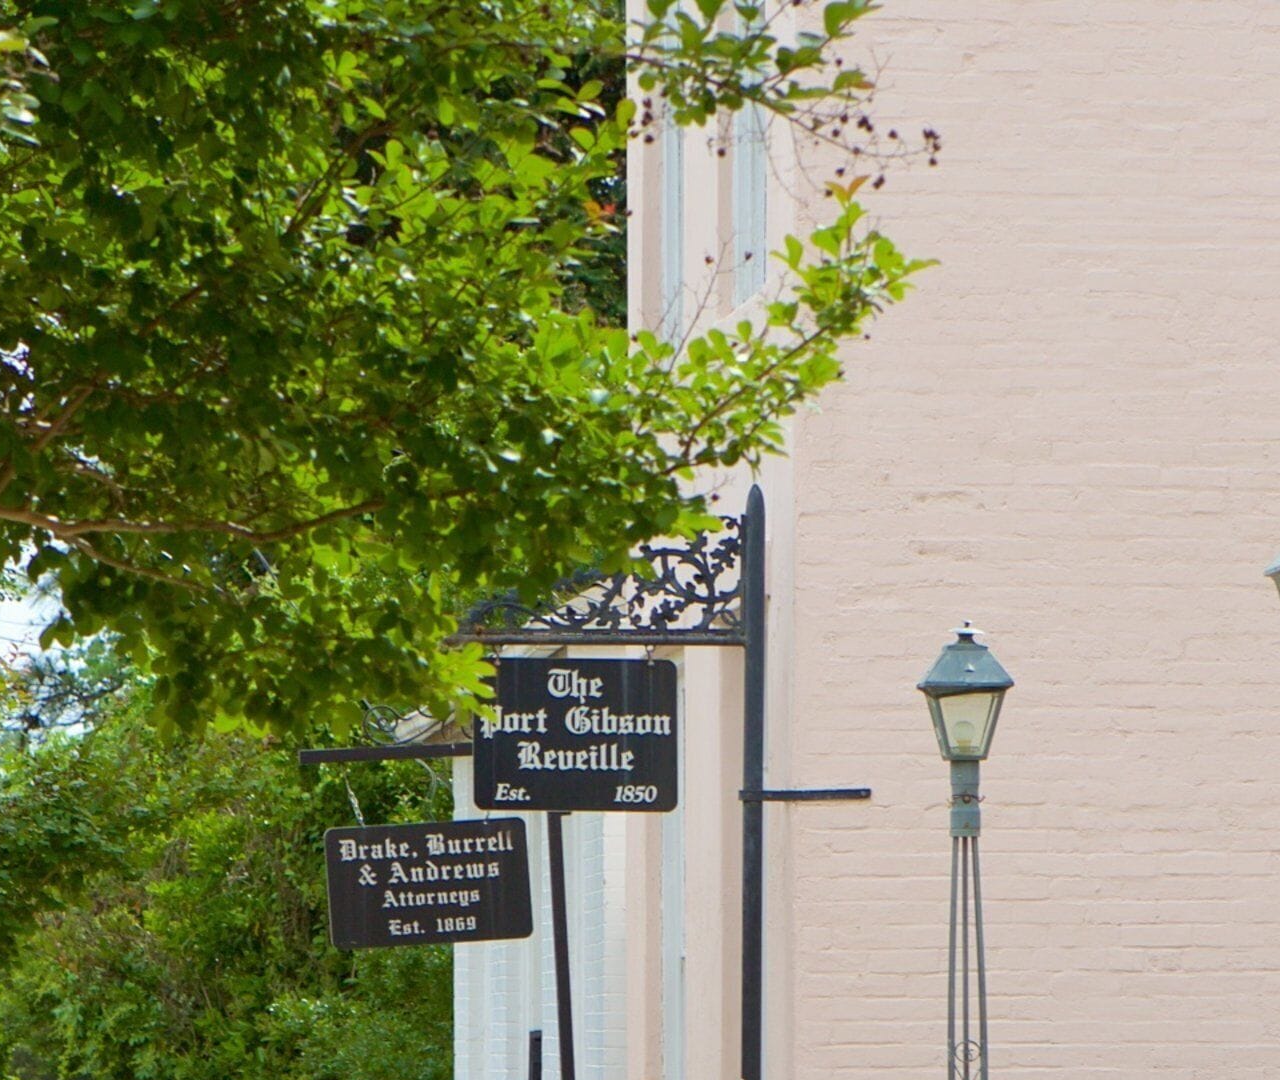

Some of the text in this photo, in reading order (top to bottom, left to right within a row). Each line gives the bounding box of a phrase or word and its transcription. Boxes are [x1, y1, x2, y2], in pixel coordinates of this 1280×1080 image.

[547, 668, 604, 704] The
[564, 704, 672, 736] Gibson
[517, 741, 635, 772] Reveille
[494, 783, 658, 803] Est. 1850
[338, 830, 515, 864] Drake, Burrell
[358, 860, 500, 887] & Andrews
[382, 888, 481, 910] Attorneys
[388, 916, 477, 937] Est. 1869
